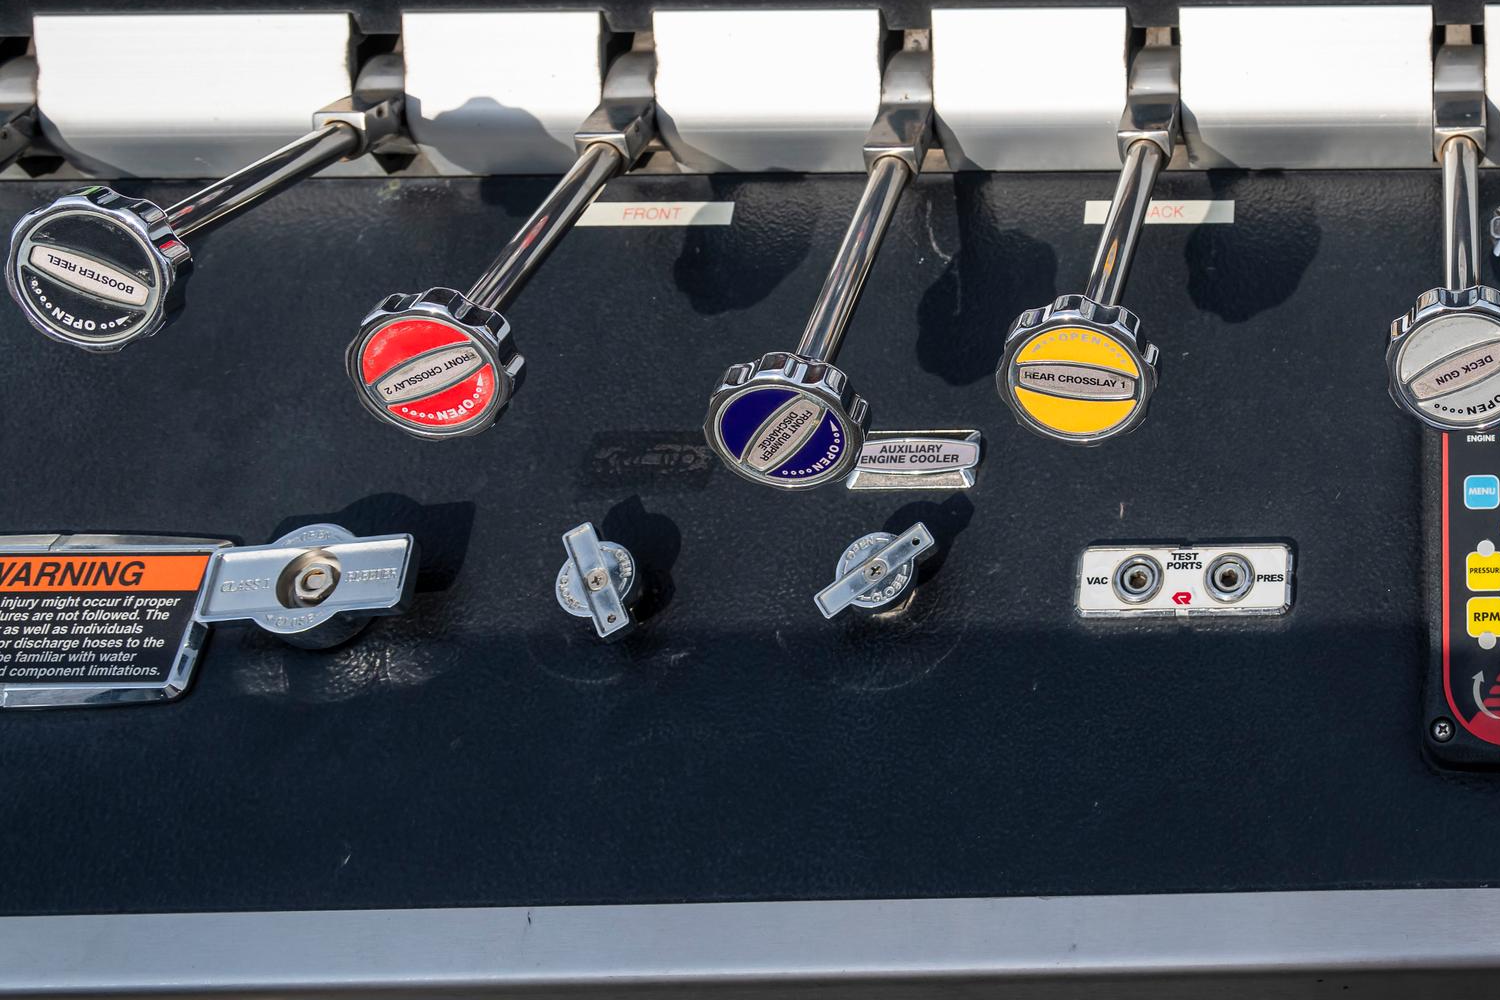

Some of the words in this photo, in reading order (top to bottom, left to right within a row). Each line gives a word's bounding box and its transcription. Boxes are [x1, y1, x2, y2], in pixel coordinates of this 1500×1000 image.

[623, 208, 681, 220] FRONT
[48, 254, 77, 271] REEL
[79, 269, 134, 295] BOOSTER
[52, 309, 96, 330] OPEN
[1059, 333, 1101, 345] OPEN
[445, 353, 478, 371] FRONT
[1463, 355, 1493, 374] DECK
[394, 366, 442, 393] CROSSLAY
[1025, 372, 1055, 381] REAR
[1058, 375, 1116, 387] CROSSLAY
[1436, 370, 1460, 385] GUN
[437, 399, 475, 420] OPEN
[788, 410, 813, 434] FRONT
[758, 411, 798, 451] DISCHARGE
[760, 433, 791, 461] BUMPER
[880, 444, 943, 454] AUXILIARY
[812, 445, 839, 471] OPEN
[861, 455, 905, 464] ENGINE
[910, 454, 959, 463] COOLER
[1469, 487, 1495, 495] MENU
[1171, 553, 1199, 561] TEST
[1167, 562, 1202, 570] PORTS
[1087, 577, 1108, 585] VAC
[1, 598, 38, 609] injury
[41, 597, 79, 610] might
[82, 598, 121, 607] occur
[123, 596, 135, 607] if
[135, 597, 180, 609] proper
[32, 612, 55, 621] are
[58, 611, 79, 620] not
[81, 609, 140, 620] followed.
[146, 609, 169, 620] The
[1474, 612, 1500, 621] RPM
